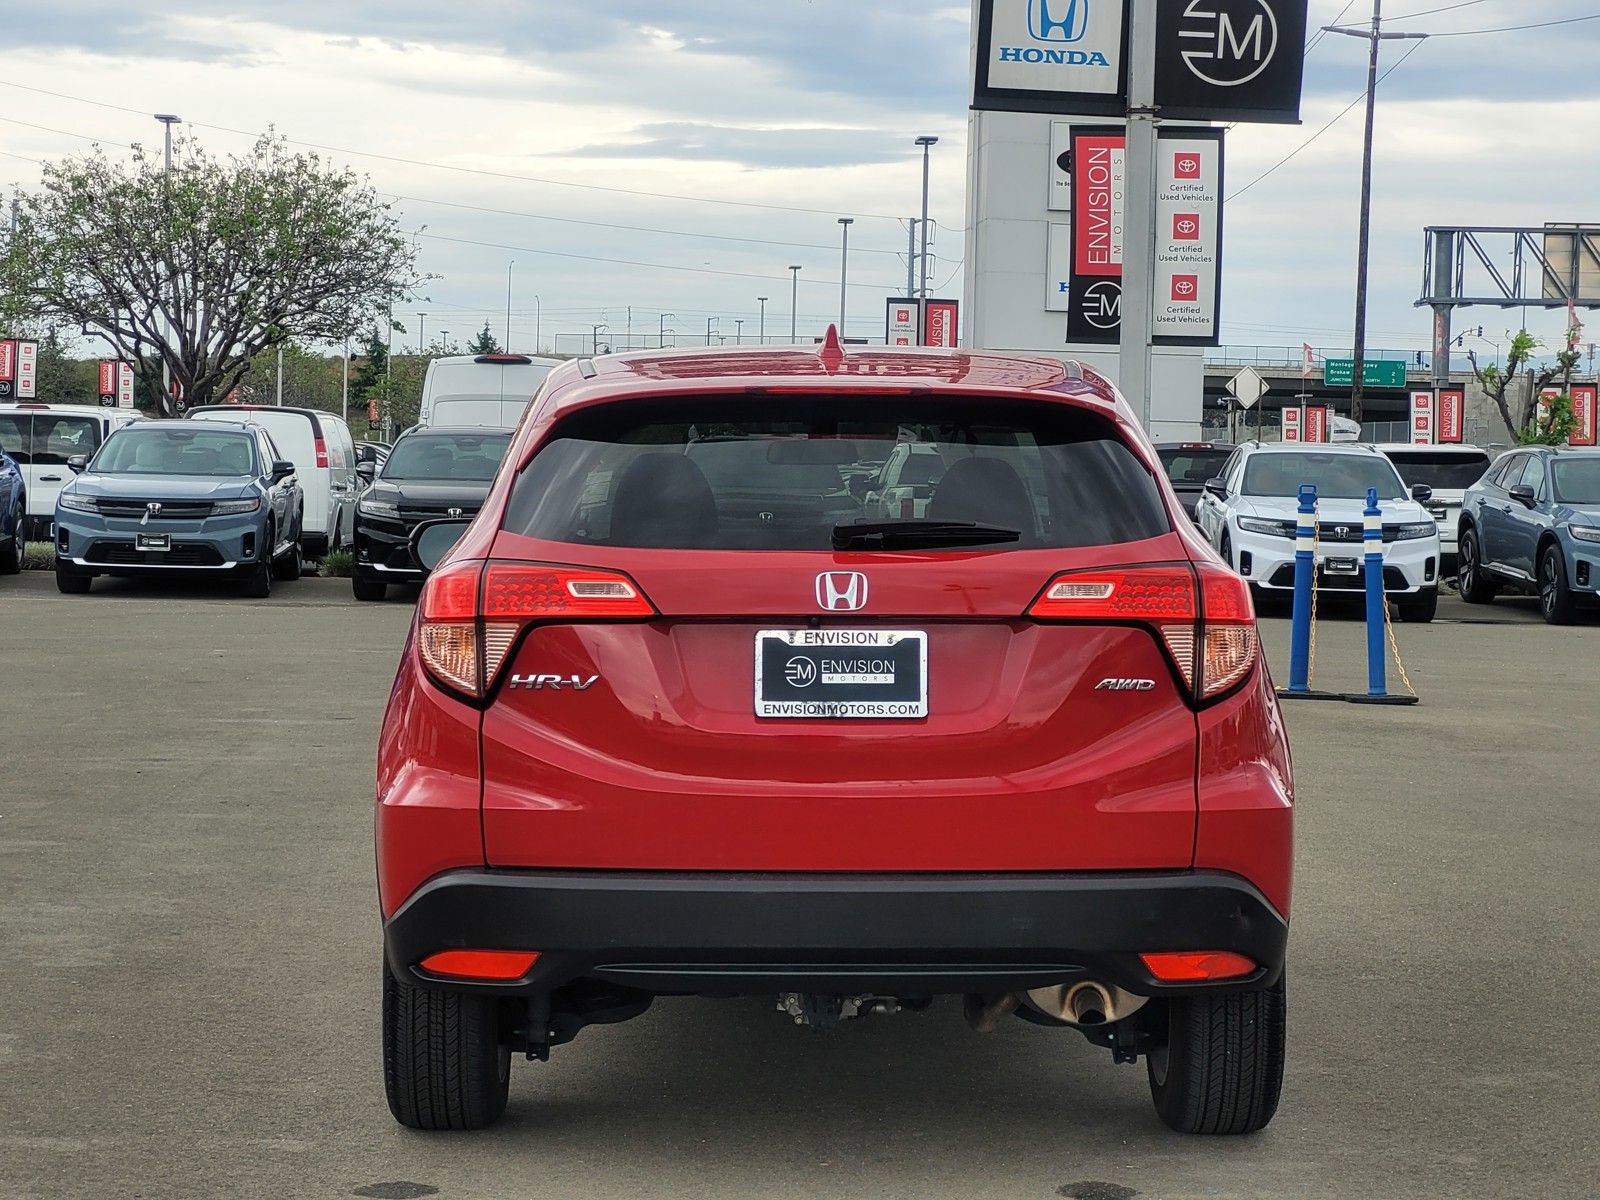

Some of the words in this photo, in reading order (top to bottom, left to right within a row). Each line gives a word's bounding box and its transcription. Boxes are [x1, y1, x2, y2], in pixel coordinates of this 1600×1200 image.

[999, 47, 1110, 67] HONDA
[1169, 184, 1204, 192] Certified
[1160, 193, 1180, 201] Used
[1181, 193, 1214, 202] Vehicles
[1088, 147, 1109, 264] ENVISION
[1113, 158, 1123, 255] MOTORS
[1168, 245, 1203, 253] Certified
[1158, 254, 1178, 262] Used
[1180, 254, 1212, 263] Vehicles
[1166, 306, 1201, 314] Certified
[1156, 315, 1177, 323] Used
[1178, 315, 1210, 324] Vehicles
[932, 309, 943, 347] VISION
[1443, 395, 1452, 438] ENVISION
[804, 632, 879, 645] ENVISION
[821, 660, 895, 673] ENVISION
[509, 674, 600, 690] HR-V
[1094, 678, 1156, 690] AWD
[763, 704, 919, 715] ENVISIONMOTORS.COM
